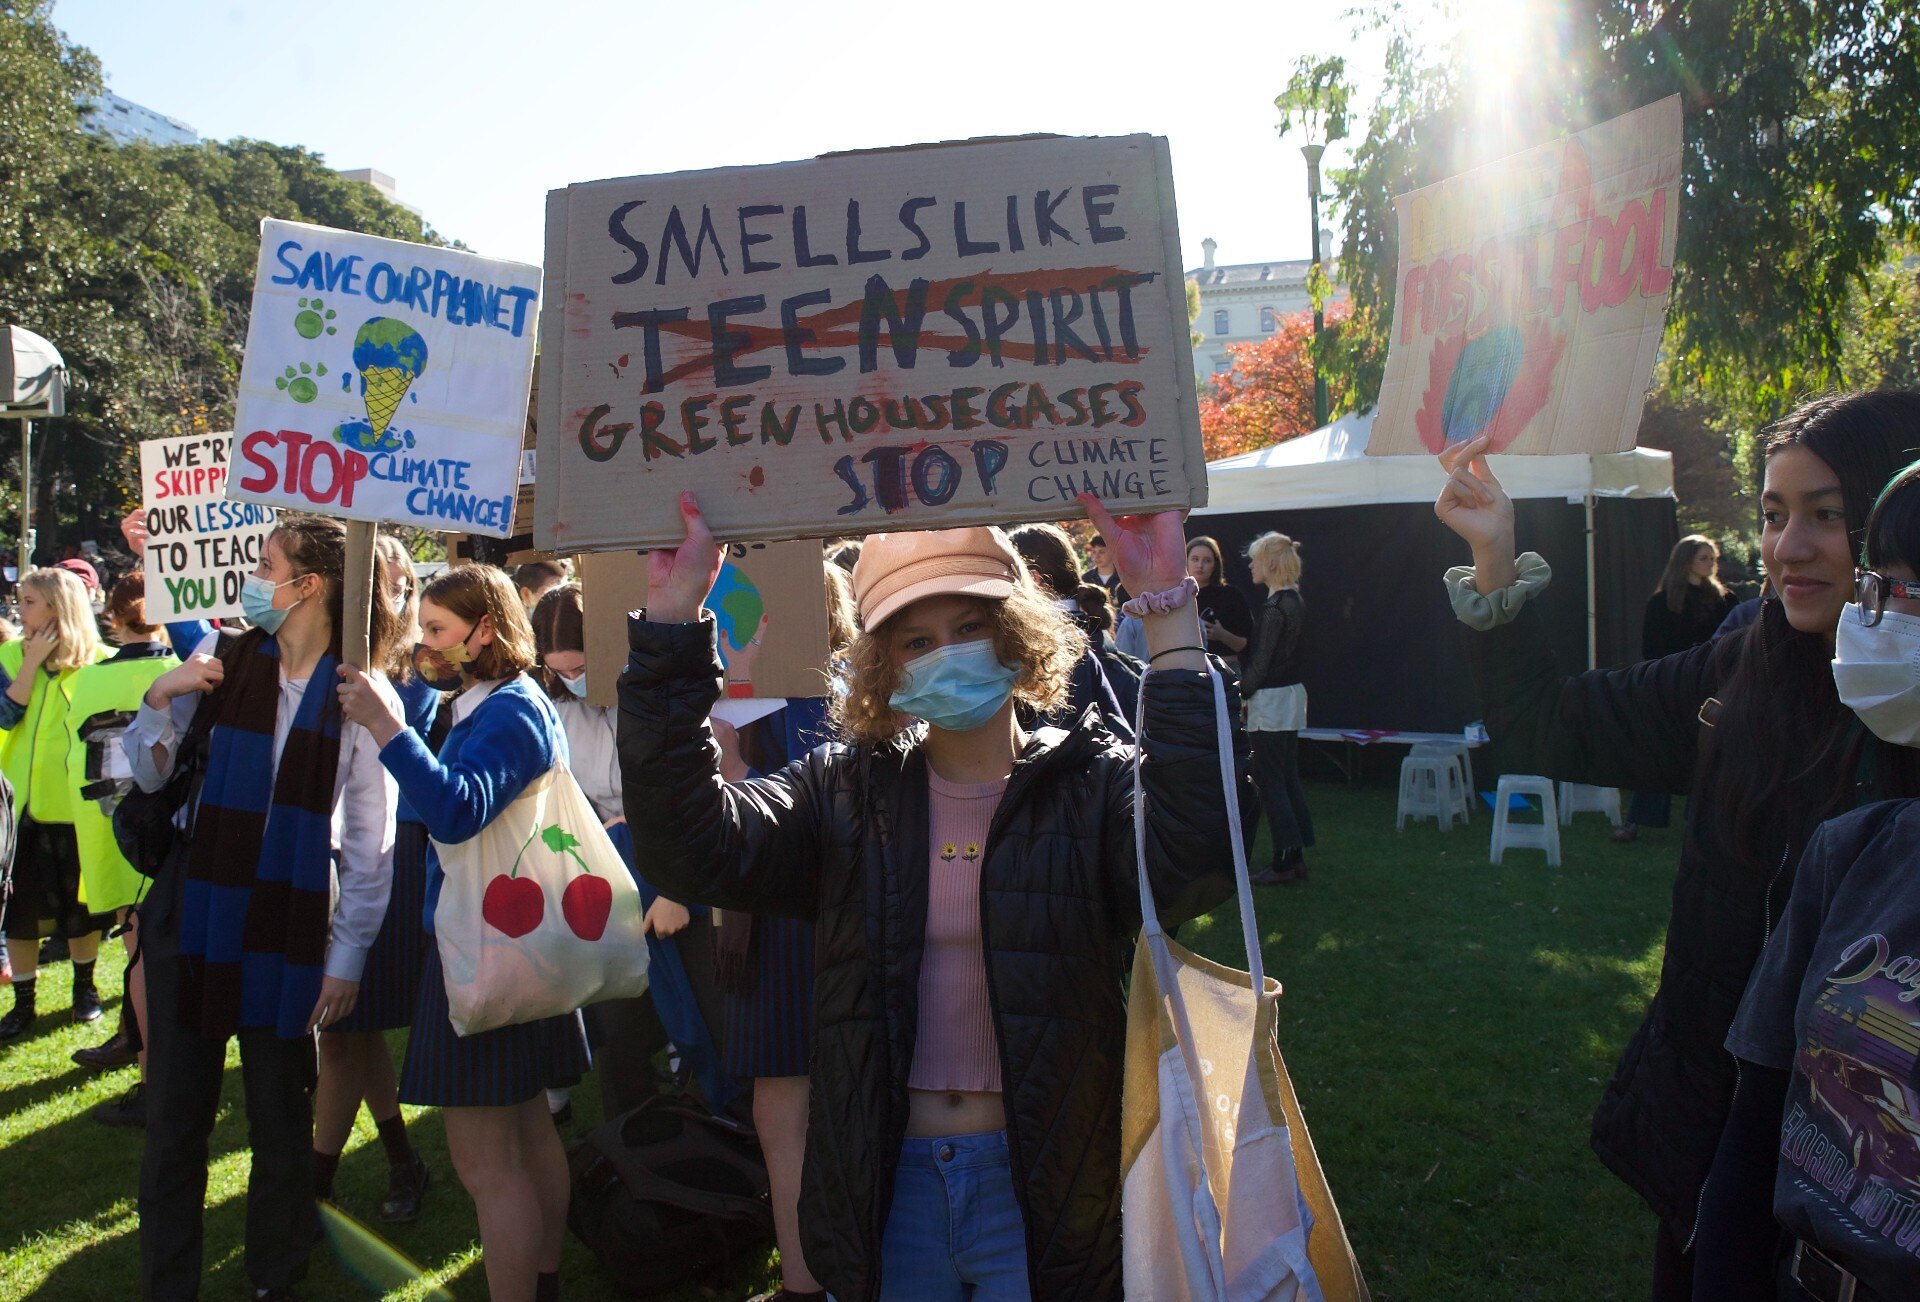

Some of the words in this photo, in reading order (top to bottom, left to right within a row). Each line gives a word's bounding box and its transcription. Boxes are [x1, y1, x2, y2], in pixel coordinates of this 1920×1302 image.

[608, 196, 937, 285] SMELLS
[954, 184, 1128, 258] LIKE
[272, 240, 364, 295] SAVE
[365, 262, 432, 313] OUR
[431, 269, 538, 337] PLANET
[612, 273, 929, 393] TEEN
[944, 272, 1160, 367] SPIRIT
[163, 438, 233, 468] WE'R
[240, 430, 368, 507] STOP
[368, 453, 471, 490] CLIMATE
[1028, 438, 1170, 468] CLIMATE
[833, 439, 1009, 516] STOP
[1028, 469, 1172, 502] CHANGE
[147, 505, 193, 536] OUR
[406, 487, 512, 530] CHANGE!
[148, 542, 187, 573] TO
[194, 534, 264, 568] TEAC
[164, 577, 216, 614] YOU
[1781, 1101, 1857, 1204] FLORIDA
